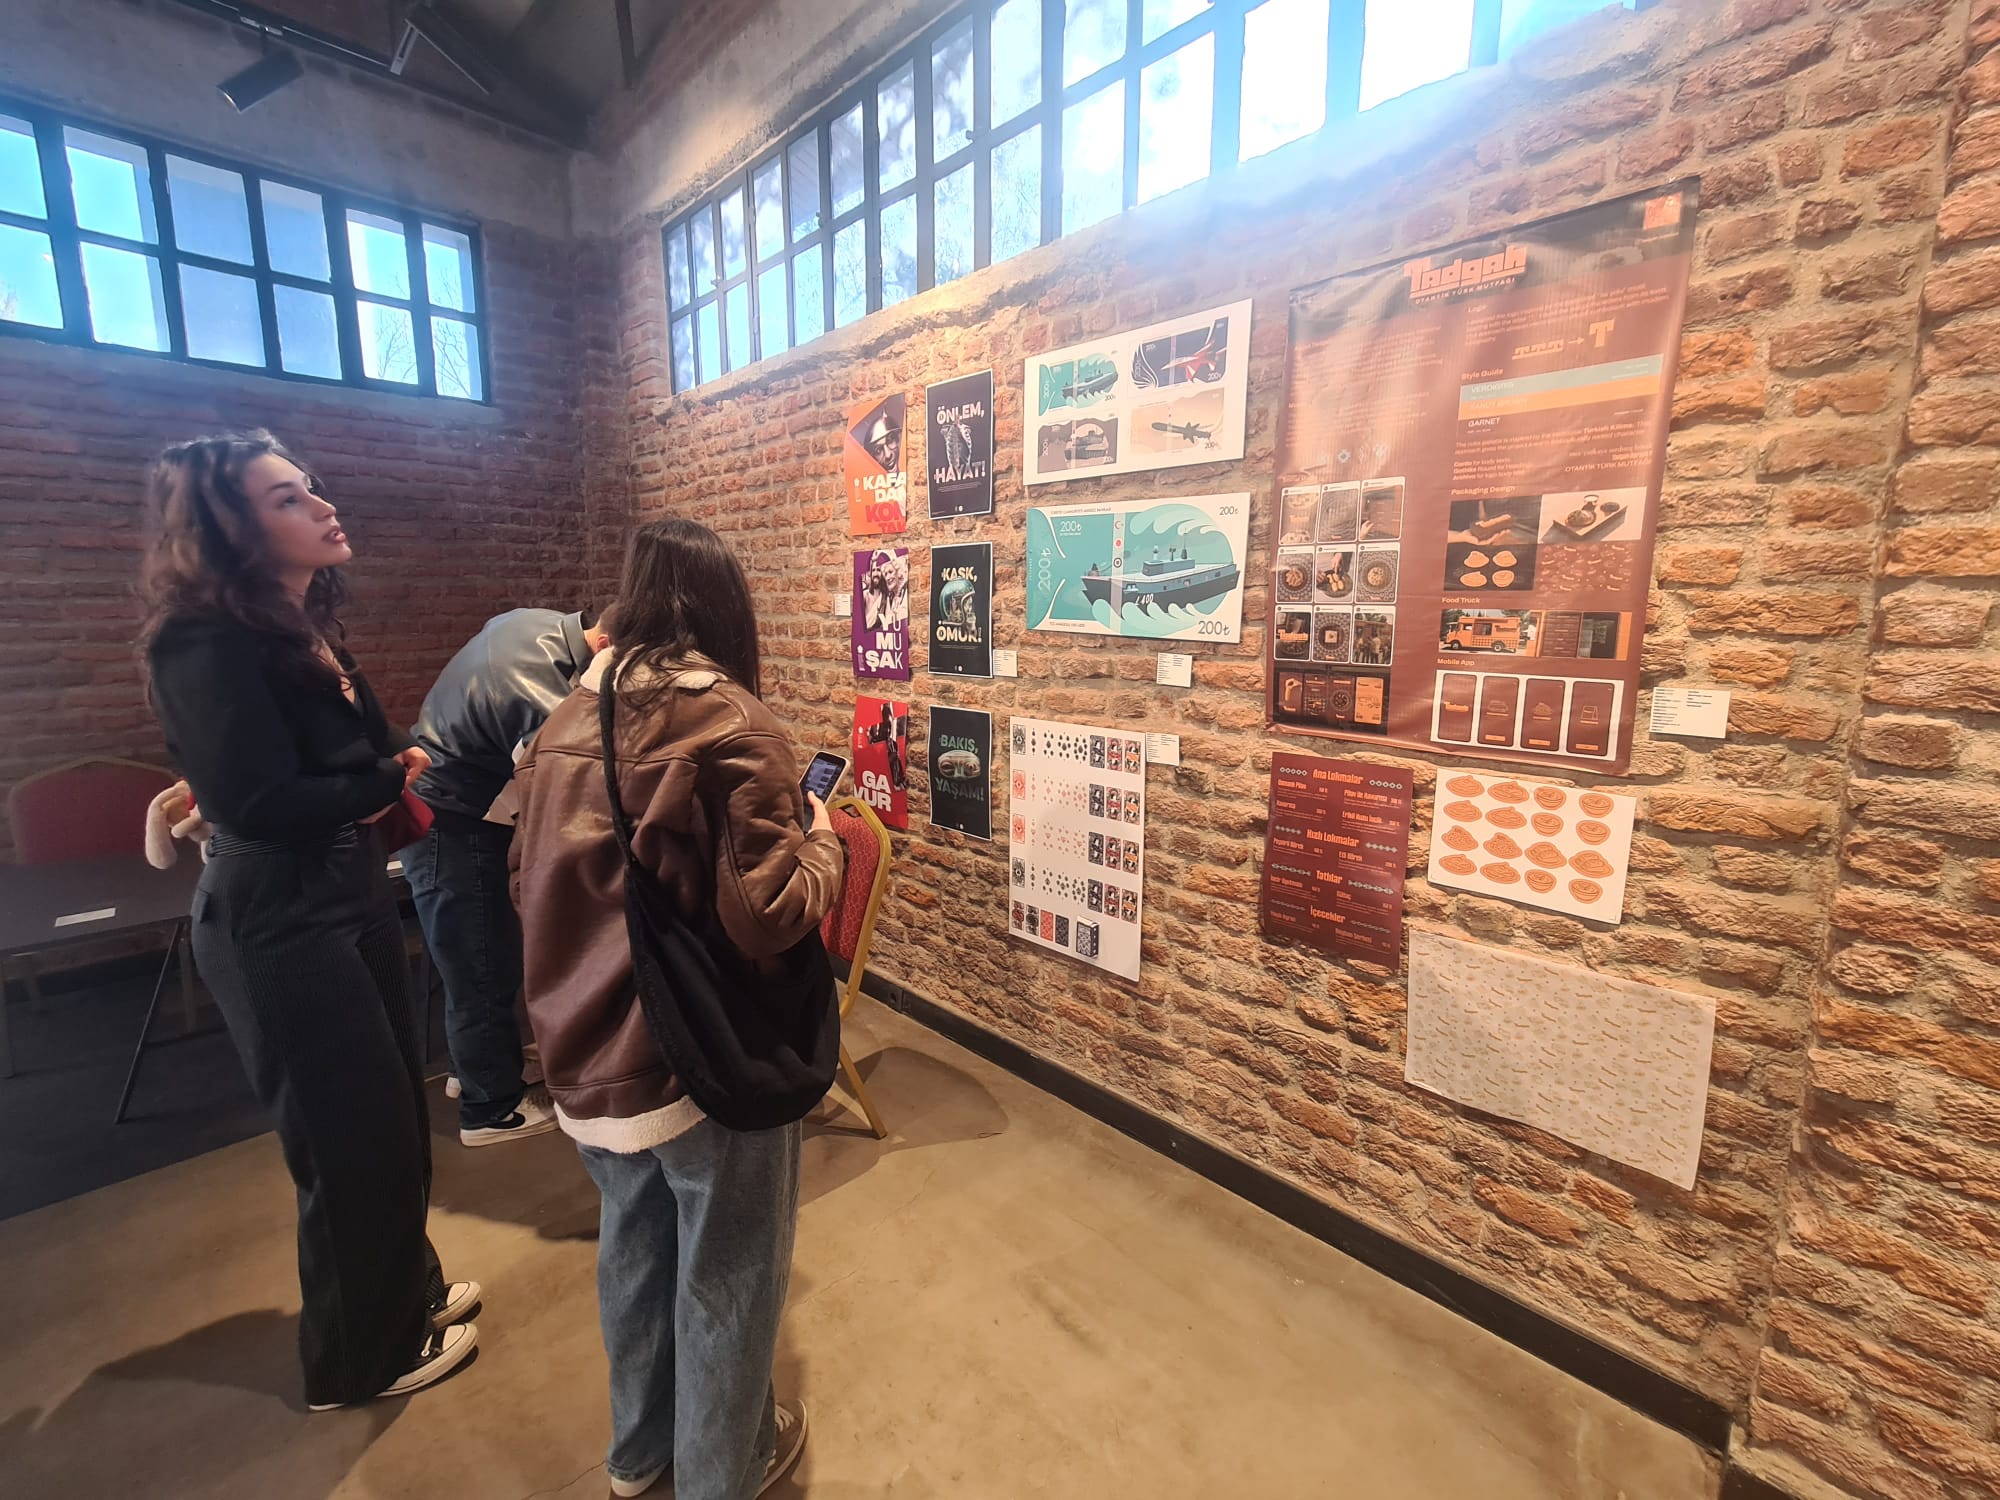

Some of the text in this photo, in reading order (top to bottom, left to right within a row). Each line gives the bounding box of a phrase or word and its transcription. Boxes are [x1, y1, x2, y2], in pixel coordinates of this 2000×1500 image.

[936, 401, 985, 425] ÖNLEM,
[863, 471, 907, 491] KAFA
[936, 460, 986, 484] HAYAT!
[943, 566, 978, 582] KASK,
[876, 632, 902, 651] MU
[865, 650, 903, 673] ŞAK
[862, 770, 892, 794] GA
[1313, 768, 1327, 780] Ana
[853, 783, 892, 812] VUR
